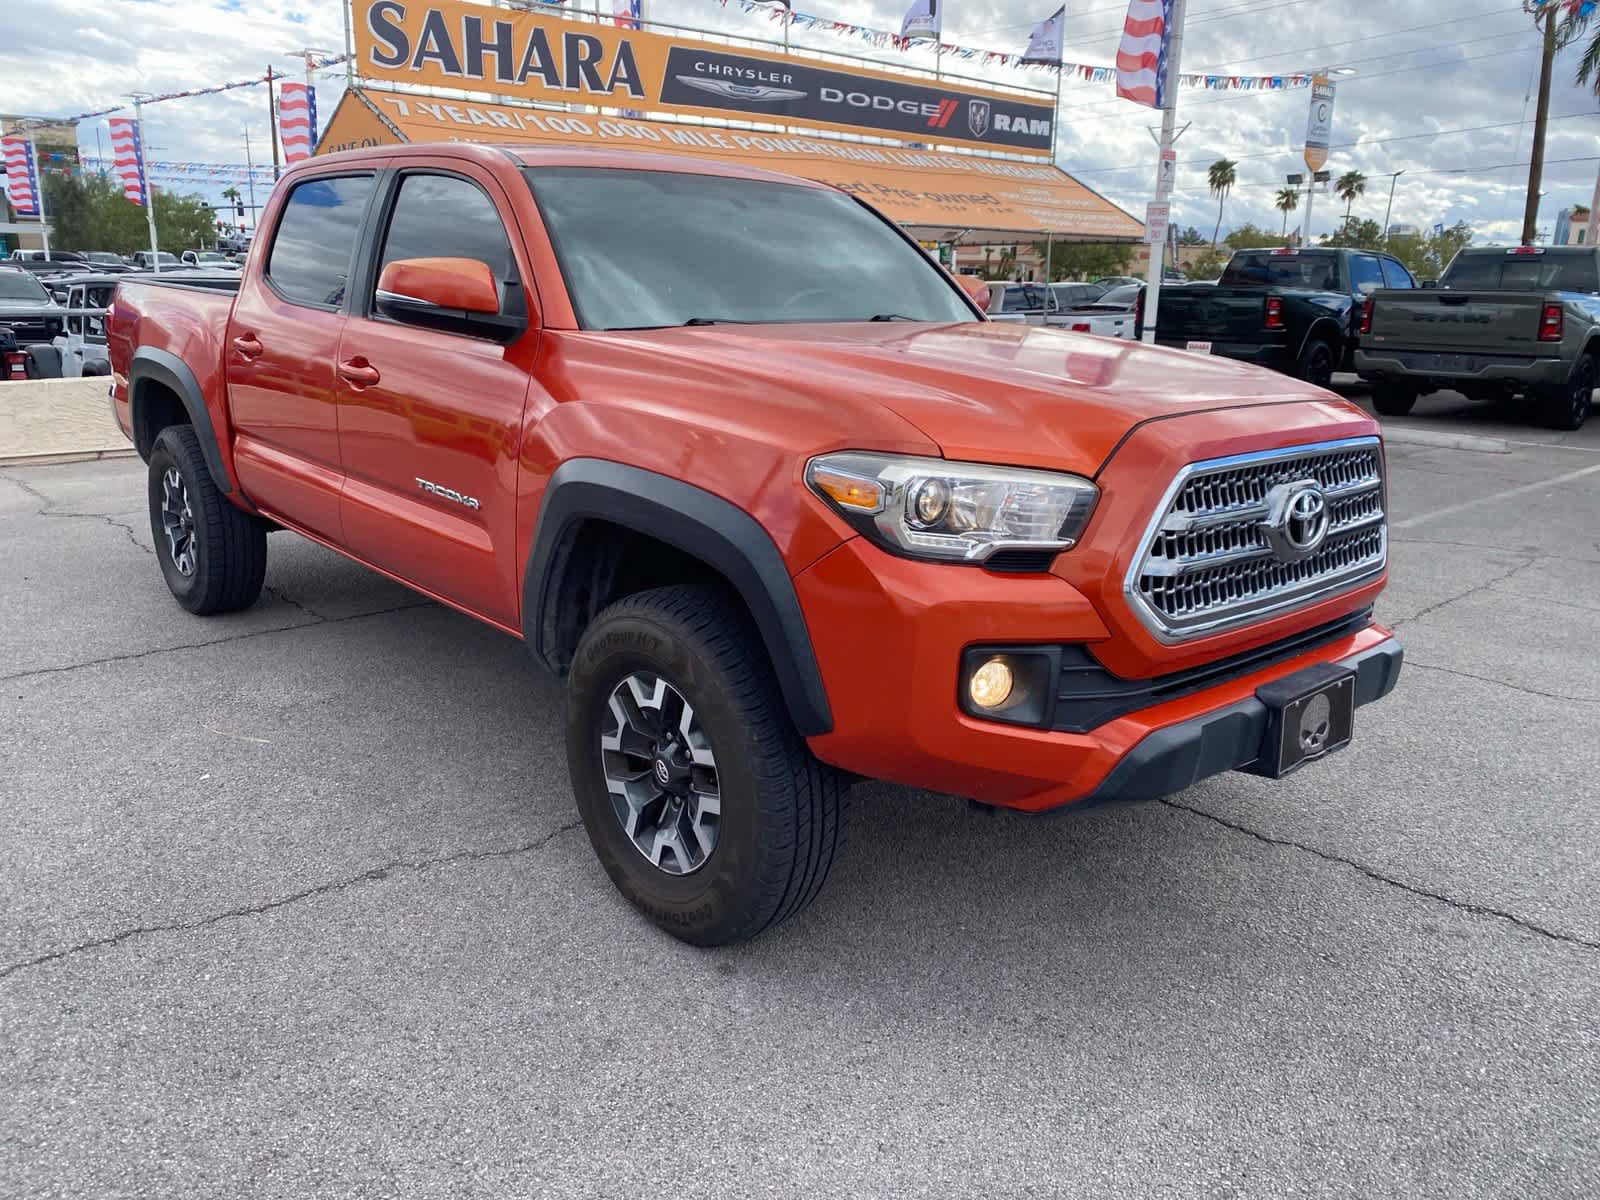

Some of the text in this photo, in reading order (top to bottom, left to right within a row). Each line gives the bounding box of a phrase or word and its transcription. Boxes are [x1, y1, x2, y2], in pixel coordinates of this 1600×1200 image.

[366, 0, 646, 99] SAHARA
[694, 61, 794, 85] CHRYSLER
[820, 87, 942, 118] DODGE
[994, 113, 1051, 137] RAM
[660, 127, 736, 150] MILE
[731, 135, 892, 164] POWERTRAIN
[415, 477, 480, 510] TACOMA
